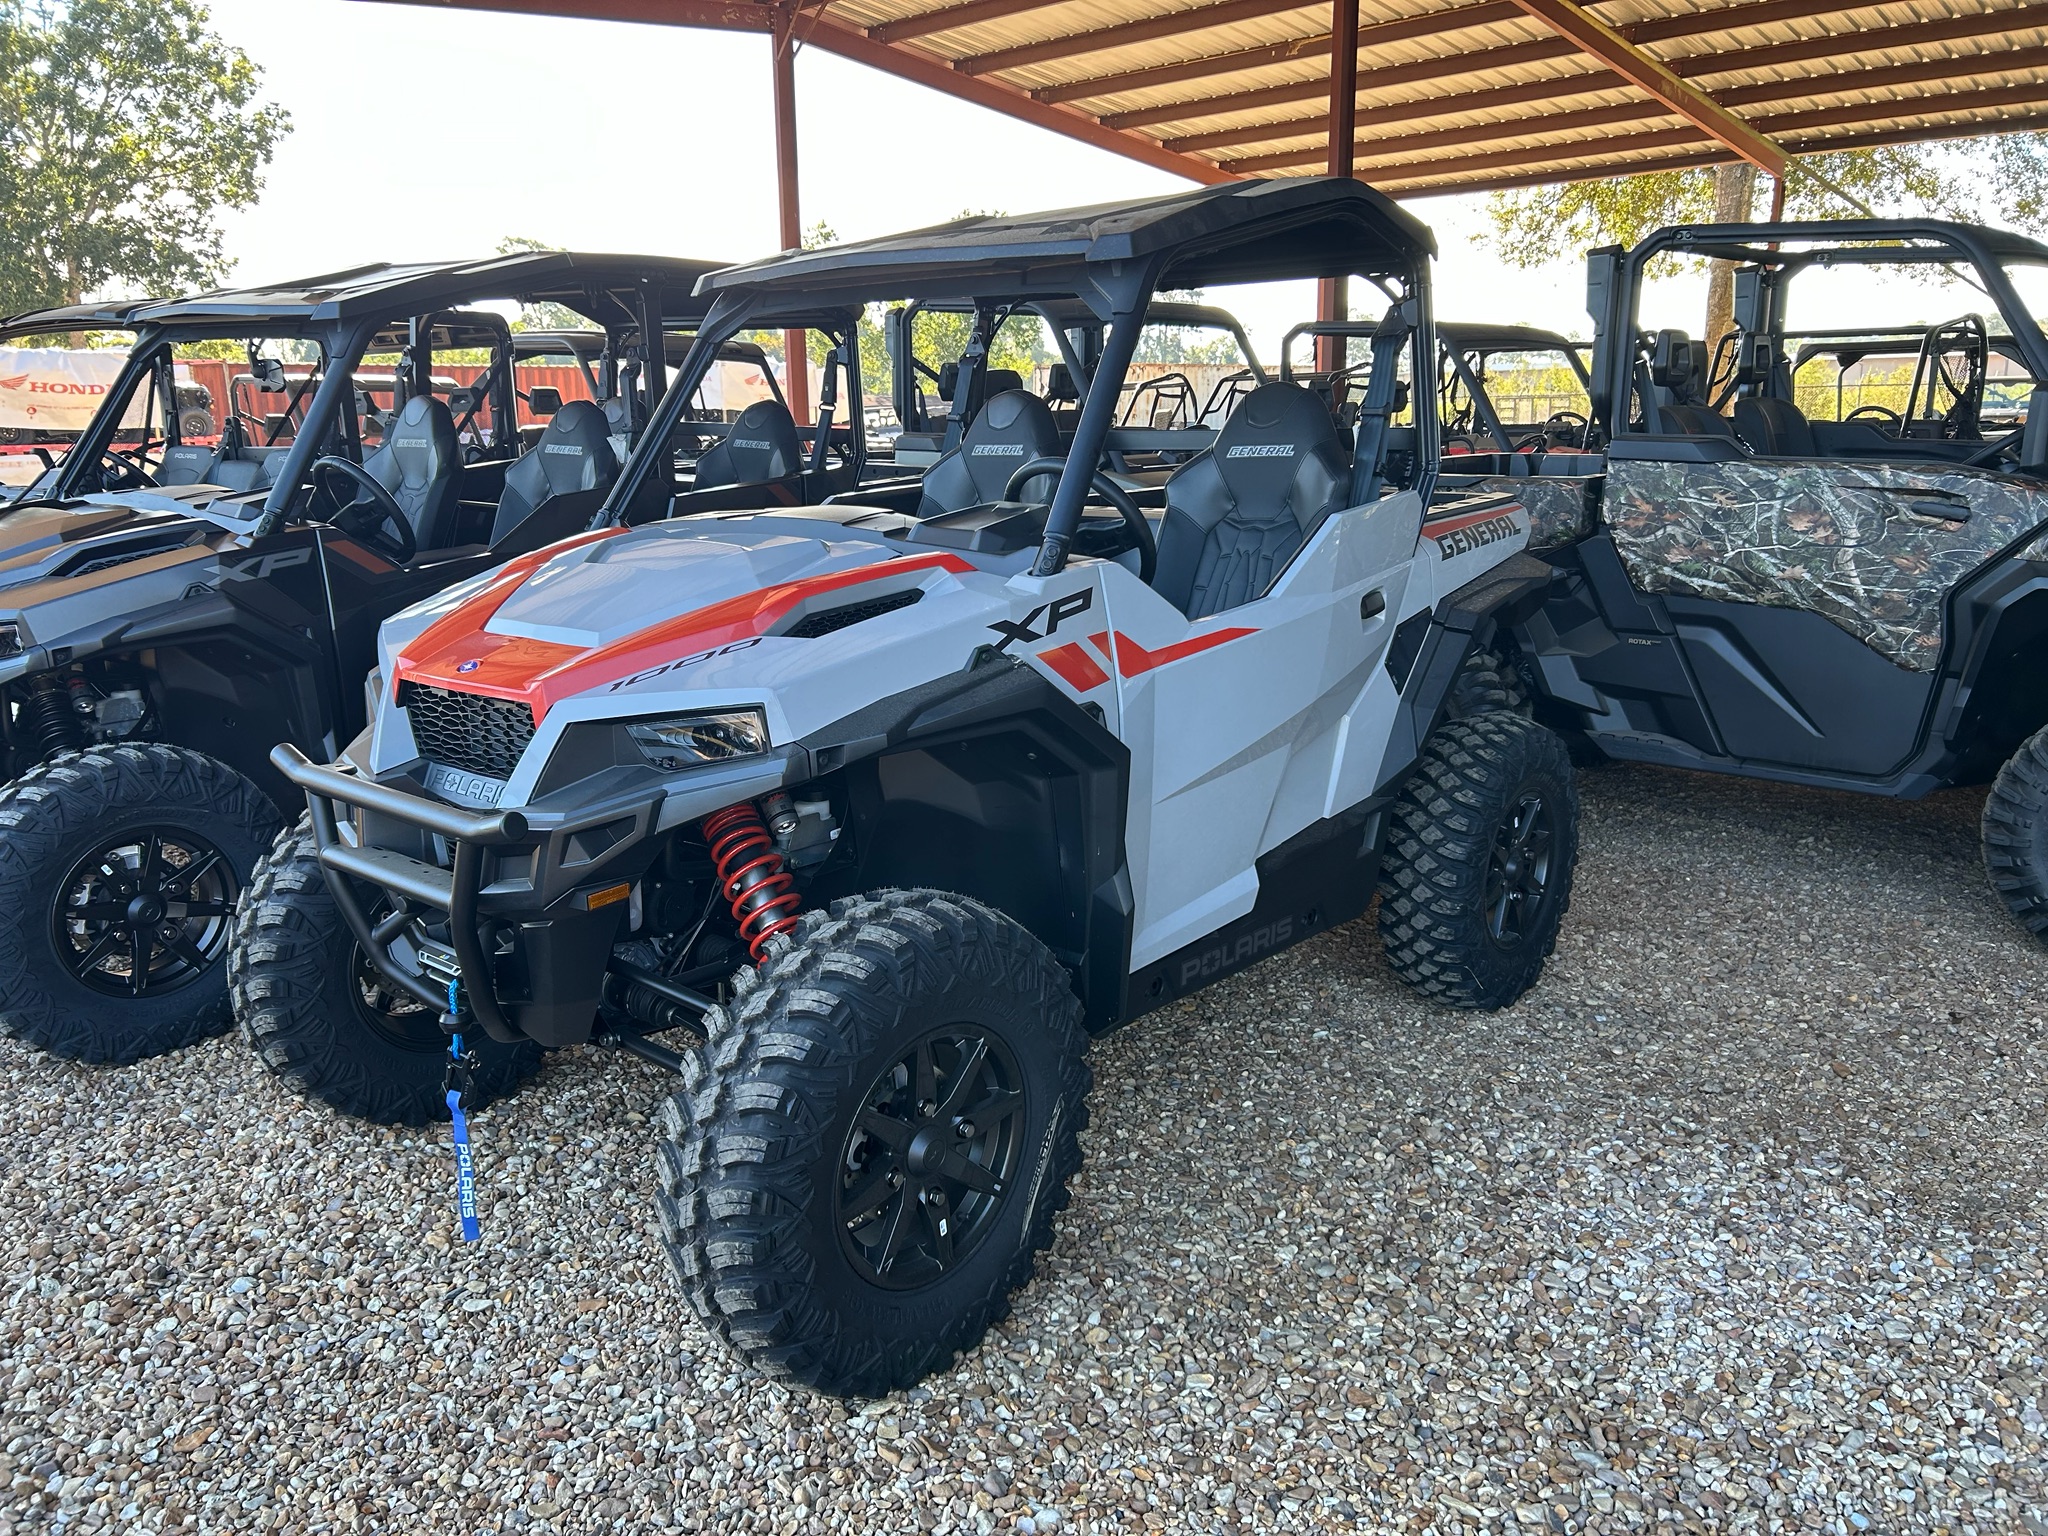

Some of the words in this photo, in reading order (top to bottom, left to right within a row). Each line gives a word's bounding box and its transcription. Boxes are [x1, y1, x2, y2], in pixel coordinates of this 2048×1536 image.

[29, 382, 112, 395] HOND
[545, 444, 583, 455] GENERAL
[733, 439, 770, 449] GENERAL
[971, 444, 1024, 456] GENERAL
[1226, 444, 1295, 458] GENERAL
[174, 452, 198, 460] POLARIS
[1434, 515, 1522, 561] GENERAL
[203, 547, 313, 587] XP
[986, 587, 1094, 652] XP
[1628, 638, 1652, 646] ROTAX
[609, 638, 763, 692] 1000
[1180, 917, 1293, 986] POLARIS
[457, 1143, 475, 1219] POLARIS
